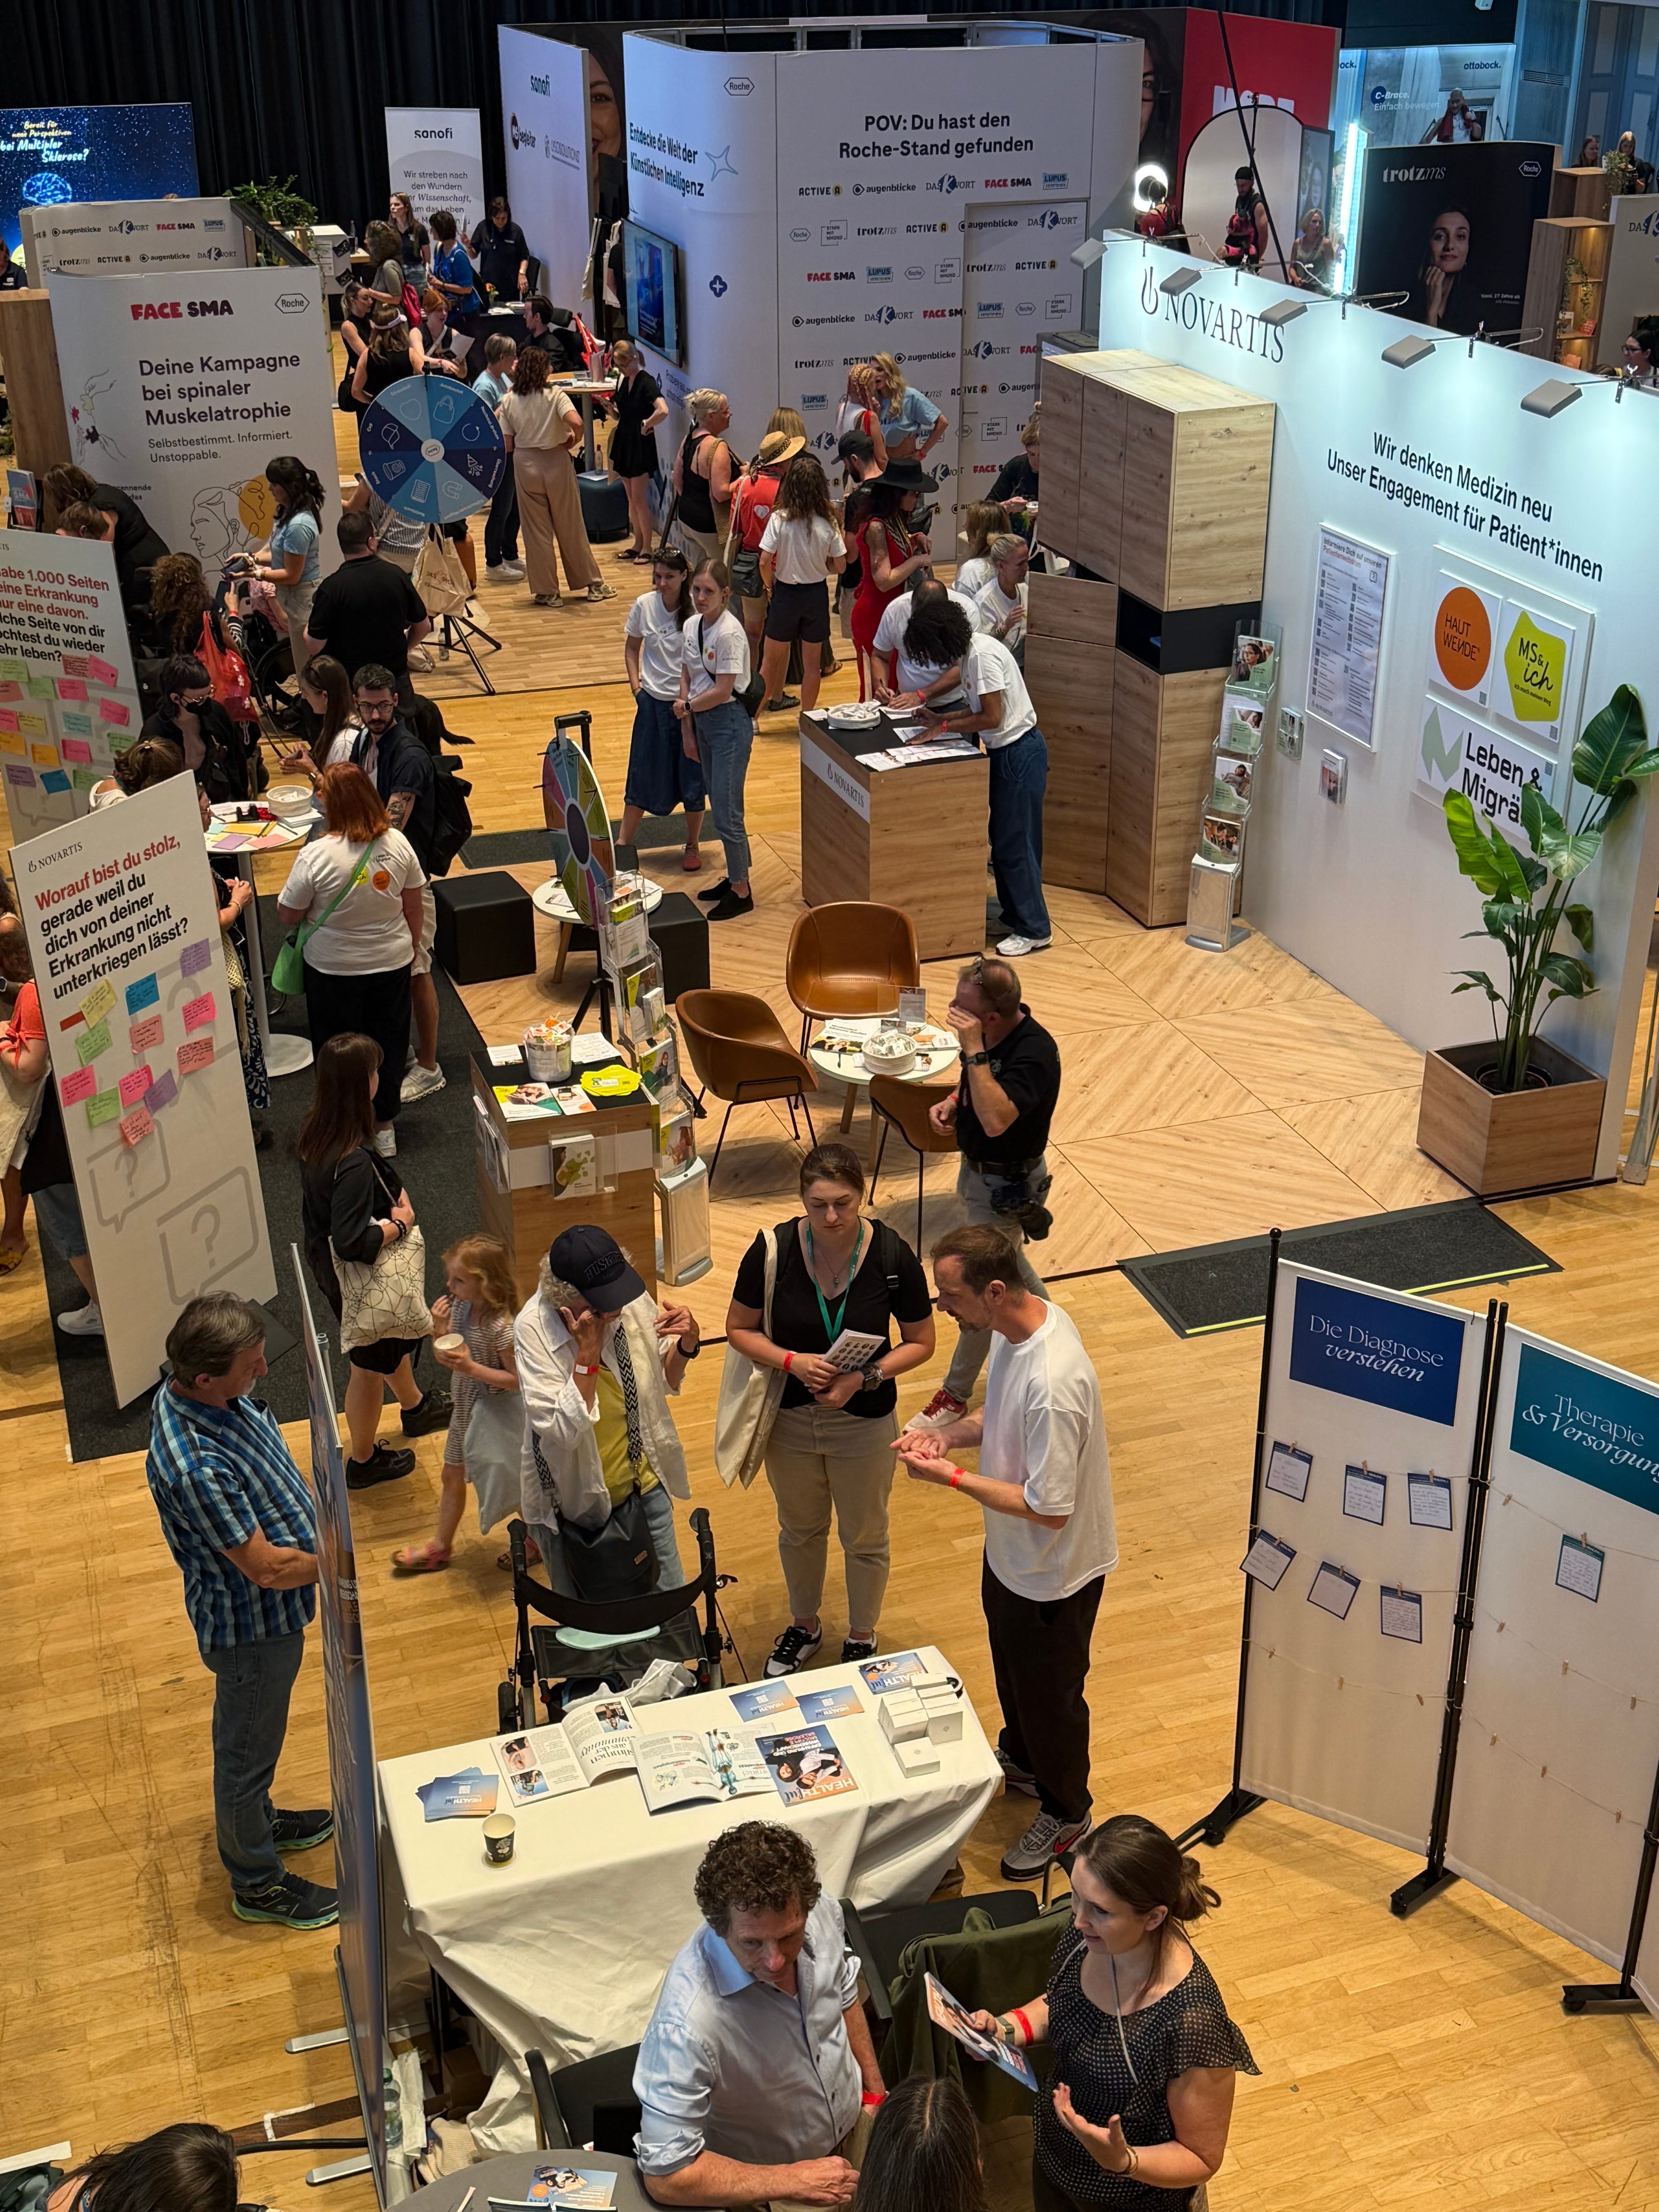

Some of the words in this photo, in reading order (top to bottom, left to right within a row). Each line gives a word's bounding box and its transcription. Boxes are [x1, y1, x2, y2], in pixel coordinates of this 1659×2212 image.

[1464, 61, 1501, 70] ottobock.
[531, 74, 550, 97] sanofi
[729, 82, 750, 91] Roche
[864, 115, 908, 131] POV:
[911, 114, 934, 130] Du
[938, 112, 976, 129] hast
[979, 112, 1011, 128] den
[414, 128, 453, 139] sanofi
[629, 123, 656, 150] Entdecke
[657, 134, 666, 152] die
[667, 136, 682, 157] Welt
[682, 144, 699, 165] der
[0, 140, 15, 151] bei
[17, 138, 63, 152] Multipler
[41, 148, 89, 163] Sklerose?
[839, 139, 950, 159] Roche-Stand
[954, 137, 1034, 159] gefunden
[630, 151, 664, 184] Künstlichen
[664, 165, 705, 198] Intelligenz
[985, 179, 1009, 188] FACE
[1011, 178, 1032, 187] SMA
[427, 182, 462, 190] Wundern
[799, 187, 831, 196] ACTIVE
[866, 183, 916, 194] augenblicke
[418, 194, 472, 204] Wissenschaft,
[62, 226, 101, 235] augenblicke
[906, 224, 937, 233] ACTIVE
[967, 219, 1018, 229] augenblicke
[807, 273, 831, 282] FACE
[833, 272, 855, 281] SMA
[130, 302, 183, 321] FACE
[187, 299, 234, 318] SMA
[280, 298, 305, 309] Roche
[923, 309, 946, 319] FACE
[806, 315, 855, 326] augenblicke
[1165, 292, 1284, 363] NOVARTIS
[139, 359, 194, 377] Deine
[200, 353, 301, 374] Kampagne
[142, 384, 172, 401] bei
[178, 381, 251, 403] spinaler
[145, 401, 292, 426] Muskelatrophie
[148, 434, 235, 449] Selbstbestimmt.
[237, 430, 292, 443] Informiert.
[149, 450, 221, 464] Unstoppable.
[1373, 432, 1397, 461] Wir
[1399, 445, 1452, 484] denken
[1457, 465, 1517, 509] Medizin
[1521, 494, 1552, 523] neu
[1327, 448, 1366, 484] Unser
[1369, 466, 1459, 523] Engagement
[1463, 504, 1485, 533] für
[1324, 537, 1345, 553] Informiere
[1346, 547, 1356, 557] Dich
[1363, 557, 1382, 569] unseren
[0, 566, 25, 580] abe
[27, 569, 64, 585] 1.000
[68, 575, 109, 591] Seiten
[25, 585, 99, 608] Erkrankung
[17, 601, 44, 613] eine
[46, 603, 89, 620] davon.
[0, 613, 25, 626] lche
[28, 616, 61, 631] Seite
[64, 623, 86, 635] von
[89, 624, 105, 638] dir
[1445, 613, 1471, 636] HAUT
[21, 646, 62, 662] leben?
[44, 634, 60, 647] du
[63, 638, 105, 654] wieder
[1524, 661, 1554, 691] ich
[1466, 732, 1524, 787] Leben
[833, 773, 864, 808] NOVARTIS
[1462, 768, 1523, 828] Migrä
[38, 842, 83, 869] NOVARTIS
[35, 872, 92, 911] Worauf
[93, 860, 120, 885] bist
[122, 852, 142, 871] du
[143, 834, 181, 861] stolz,
[40, 896, 94, 937] gerade
[96, 878, 126, 903] weil
[127, 871, 146, 891] du
[45, 927, 78, 956] dich
[80, 915, 107, 938] von
[109, 891, 155, 923] deiner
[49, 929, 136, 978] Erkrankung
[137, 904, 172, 932] nicht
[54, 941, 146, 1000] unterkriegen
[148, 917, 188, 951] lässt?
[1310, 1314, 1343, 1340] Die
[1348, 1325, 1444, 1367] Diagnose
[1325, 1343, 1425, 1382] verstehen
[1522, 1405, 1548, 1425] &
[1554, 1394, 1644, 1447] Therapie
